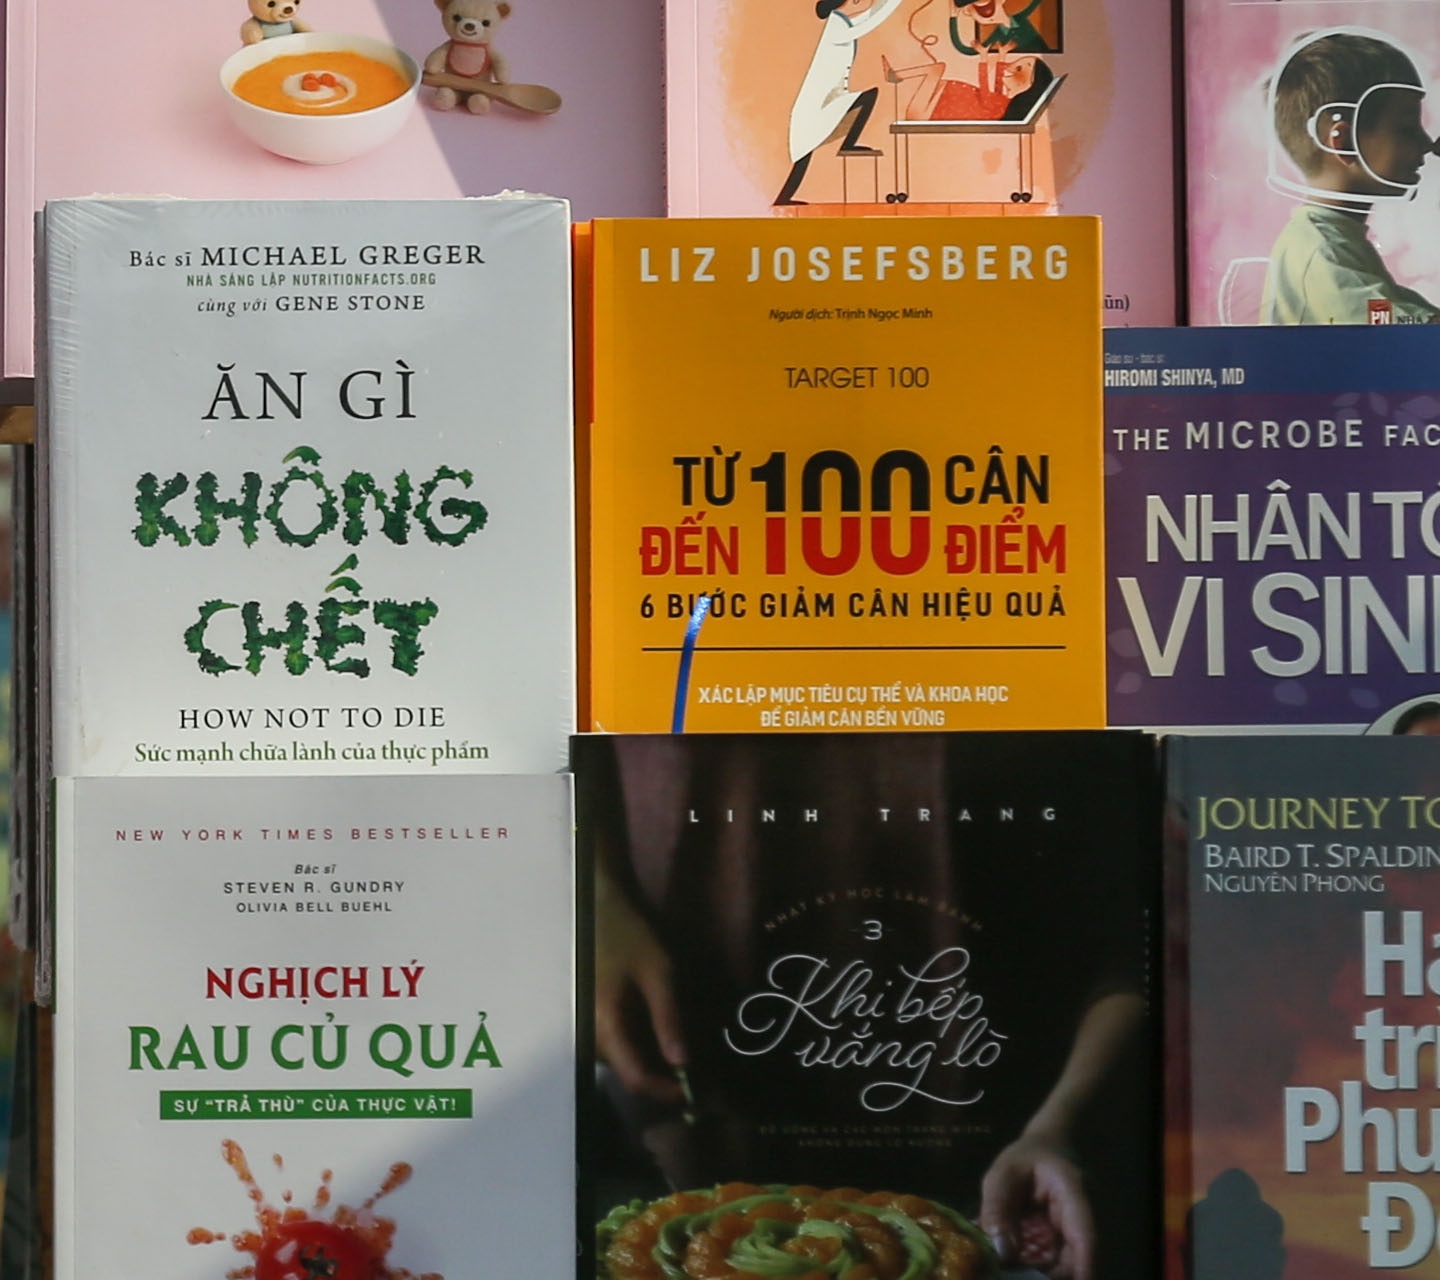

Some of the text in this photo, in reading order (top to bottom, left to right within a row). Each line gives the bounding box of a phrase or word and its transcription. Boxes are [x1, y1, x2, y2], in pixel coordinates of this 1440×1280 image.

[129, 245, 486, 269] Bác sĩ MICHAEL GREGER
[640, 245, 1068, 283] LIZ JOSEFSBERG
[293, 273, 436, 287] NUTRITIONFACTS.ORG
[276, 295, 426, 313] GENE STONE
[202, 359, 417, 421] ĂN GÌ
[785, 366, 930, 389] TARGET 100
[1114, 428, 1170, 451] THE
[1186, 419, 1363, 449] MICROBE
[132, 445, 488, 548] KHÔNG
[673, 446, 1050, 576] TỪ 100 CÂN
[1146, 479, 1361, 562] NHÂN
[639, 505, 1067, 576] ĐẾN ĐIỂM
[184, 553, 439, 678] CHẾT
[640, 585, 1066, 621] 6 GIẢM CÂN HIỆU QUẢ
[1118, 576, 1225, 677] VI
[179, 707, 446, 730] HOW NOT TO DIE
[690, 808, 1056, 823] LINH TRANG
[224, 882, 296, 895] STEVEN
[331, 881, 405, 894] GUNDRY
[205, 960, 425, 1005] NGHỊCH LÝ
[128, 1011, 503, 1078] RAU CỦ QUẢ
